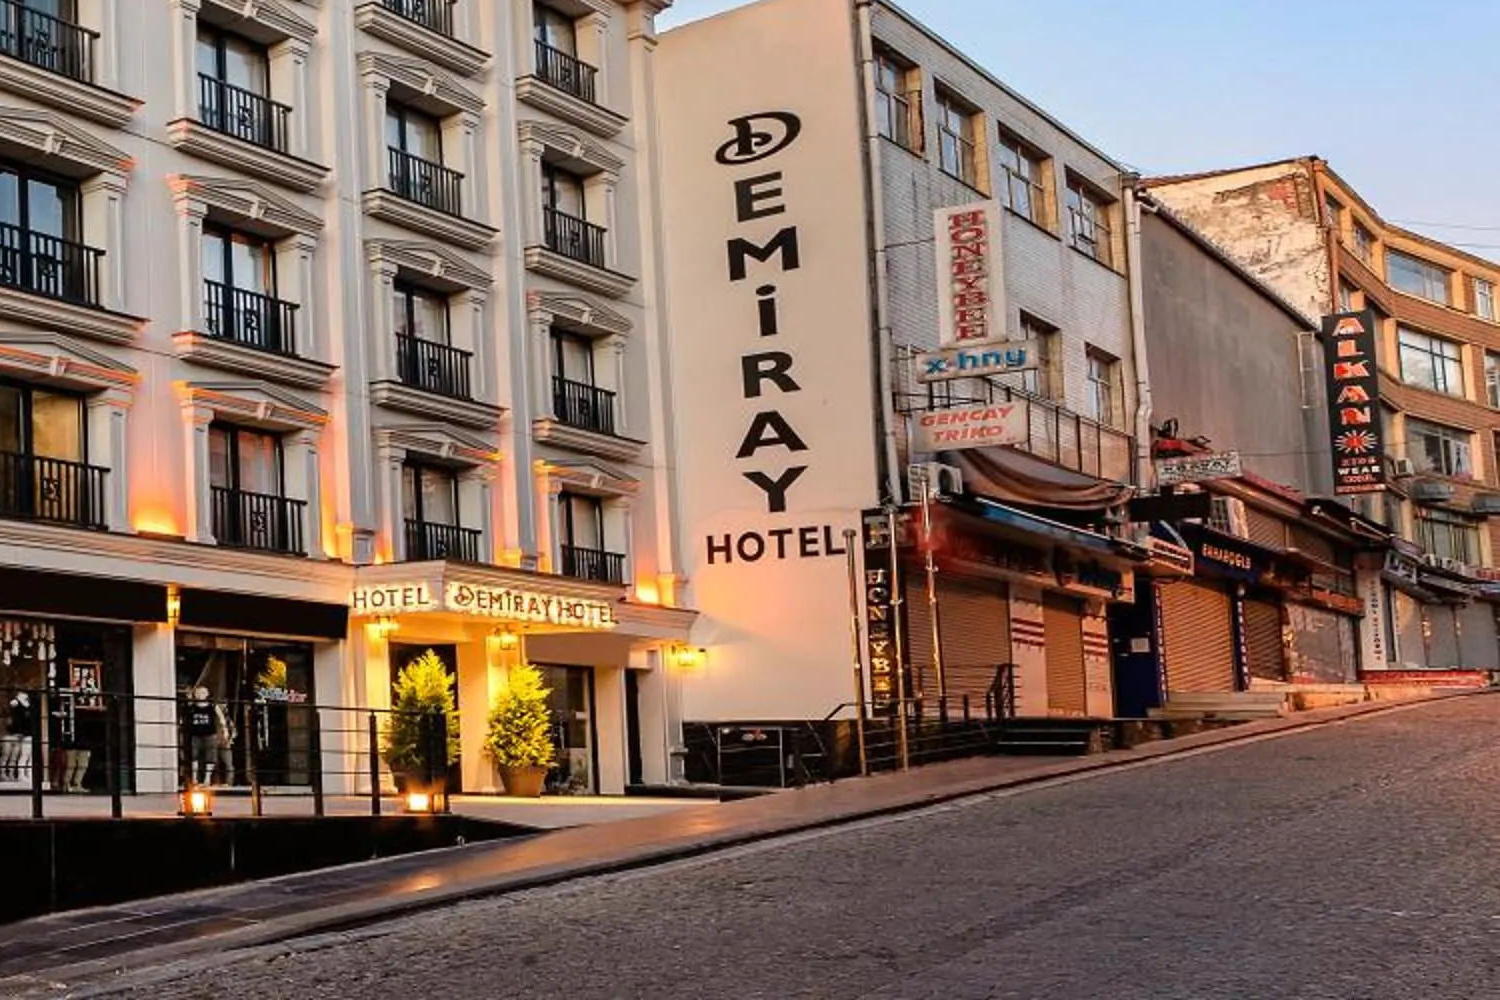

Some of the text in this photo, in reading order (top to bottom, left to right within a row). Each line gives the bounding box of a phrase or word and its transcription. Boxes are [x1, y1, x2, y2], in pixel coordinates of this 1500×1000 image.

[1332, 317, 1371, 425] ALKAN
[706, 525, 847, 565] HOTEL
[353, 587, 429, 609] HOTEL
[557, 602, 619, 624] HOTEL
